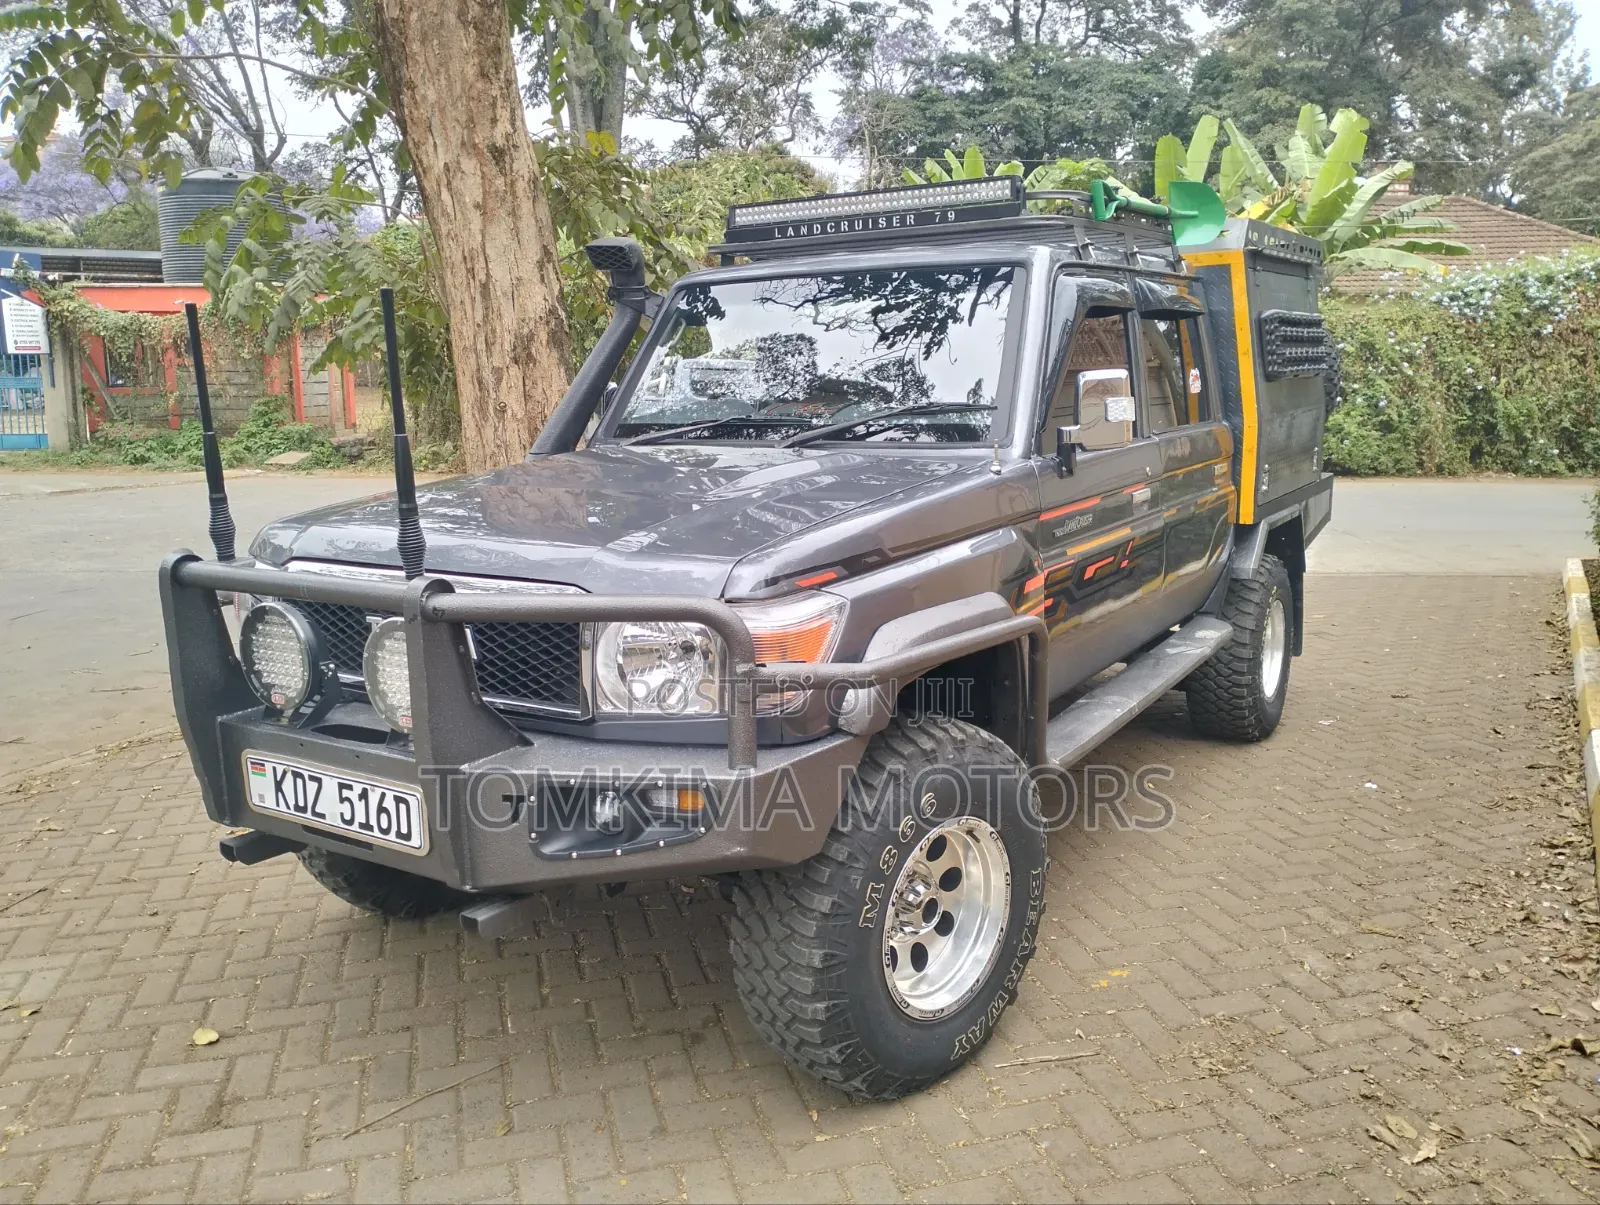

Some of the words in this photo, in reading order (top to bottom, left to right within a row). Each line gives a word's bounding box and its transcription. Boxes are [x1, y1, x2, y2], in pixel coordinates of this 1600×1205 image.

[775, 213, 916, 239] LANDCRUISER
[934, 210, 956, 223] 79
[272, 765, 327, 820] KDZ
[337, 781, 413, 842] 516D
[950, 867, 1042, 1061] BEARWAY
